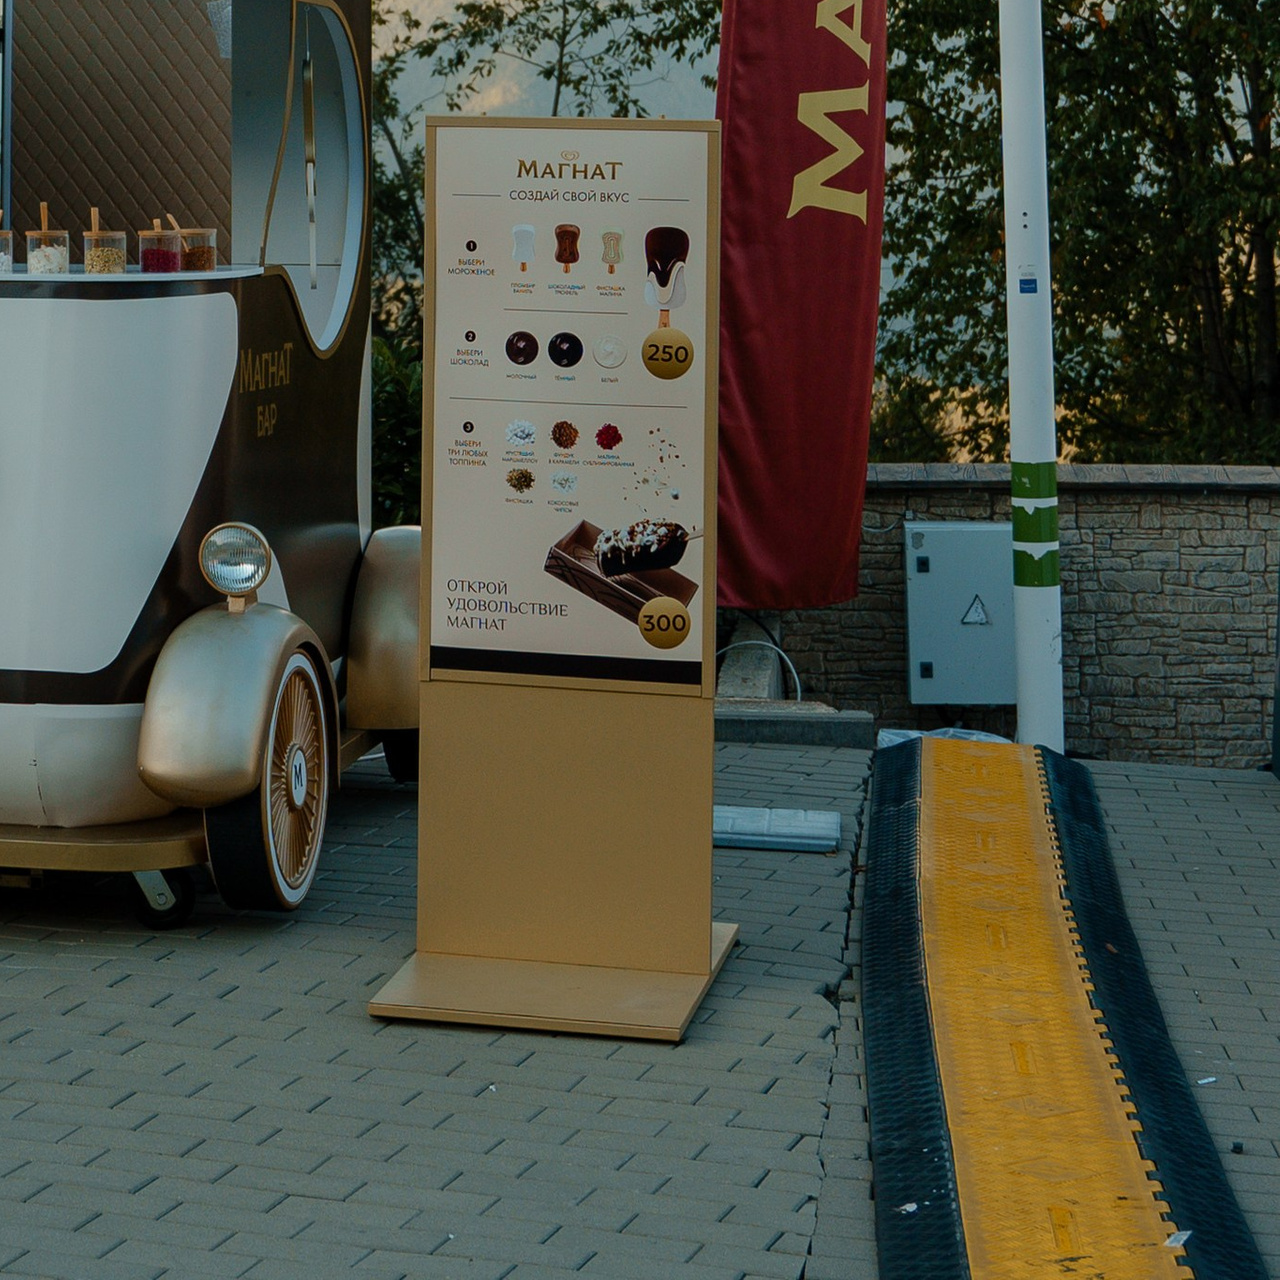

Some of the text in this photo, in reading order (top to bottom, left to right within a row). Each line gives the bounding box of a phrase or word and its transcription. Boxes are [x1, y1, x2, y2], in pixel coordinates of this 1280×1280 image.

[517, 159, 623, 181] МАГНАТ
[509, 188, 630, 203] СОЗДАЙ СВОЙ ВКУС
[458, 258, 485, 266] ВЫБЕРИ
[448, 267, 495, 276] МОРОЖЕНОЕ
[456, 348, 483, 357] ВЫБЕРИ
[647, 343, 689, 364] 250
[239, 342, 293, 393] МАГНАТ
[450, 358, 489, 367] ШОКОЛАД
[257, 403, 277, 437] БАР
[454, 439, 482, 447] ВЫБЕРИ
[462, 449, 488, 457] ЛЮБЫХ
[449, 458, 487, 466] ТОППИНГА
[447, 579, 508, 595] ОТКРОЙ
[447, 597, 569, 617] УДОВОЛЬСТВИЕ
[446, 615, 507, 631] МАГНАТ
[643, 614, 686, 632] 300
